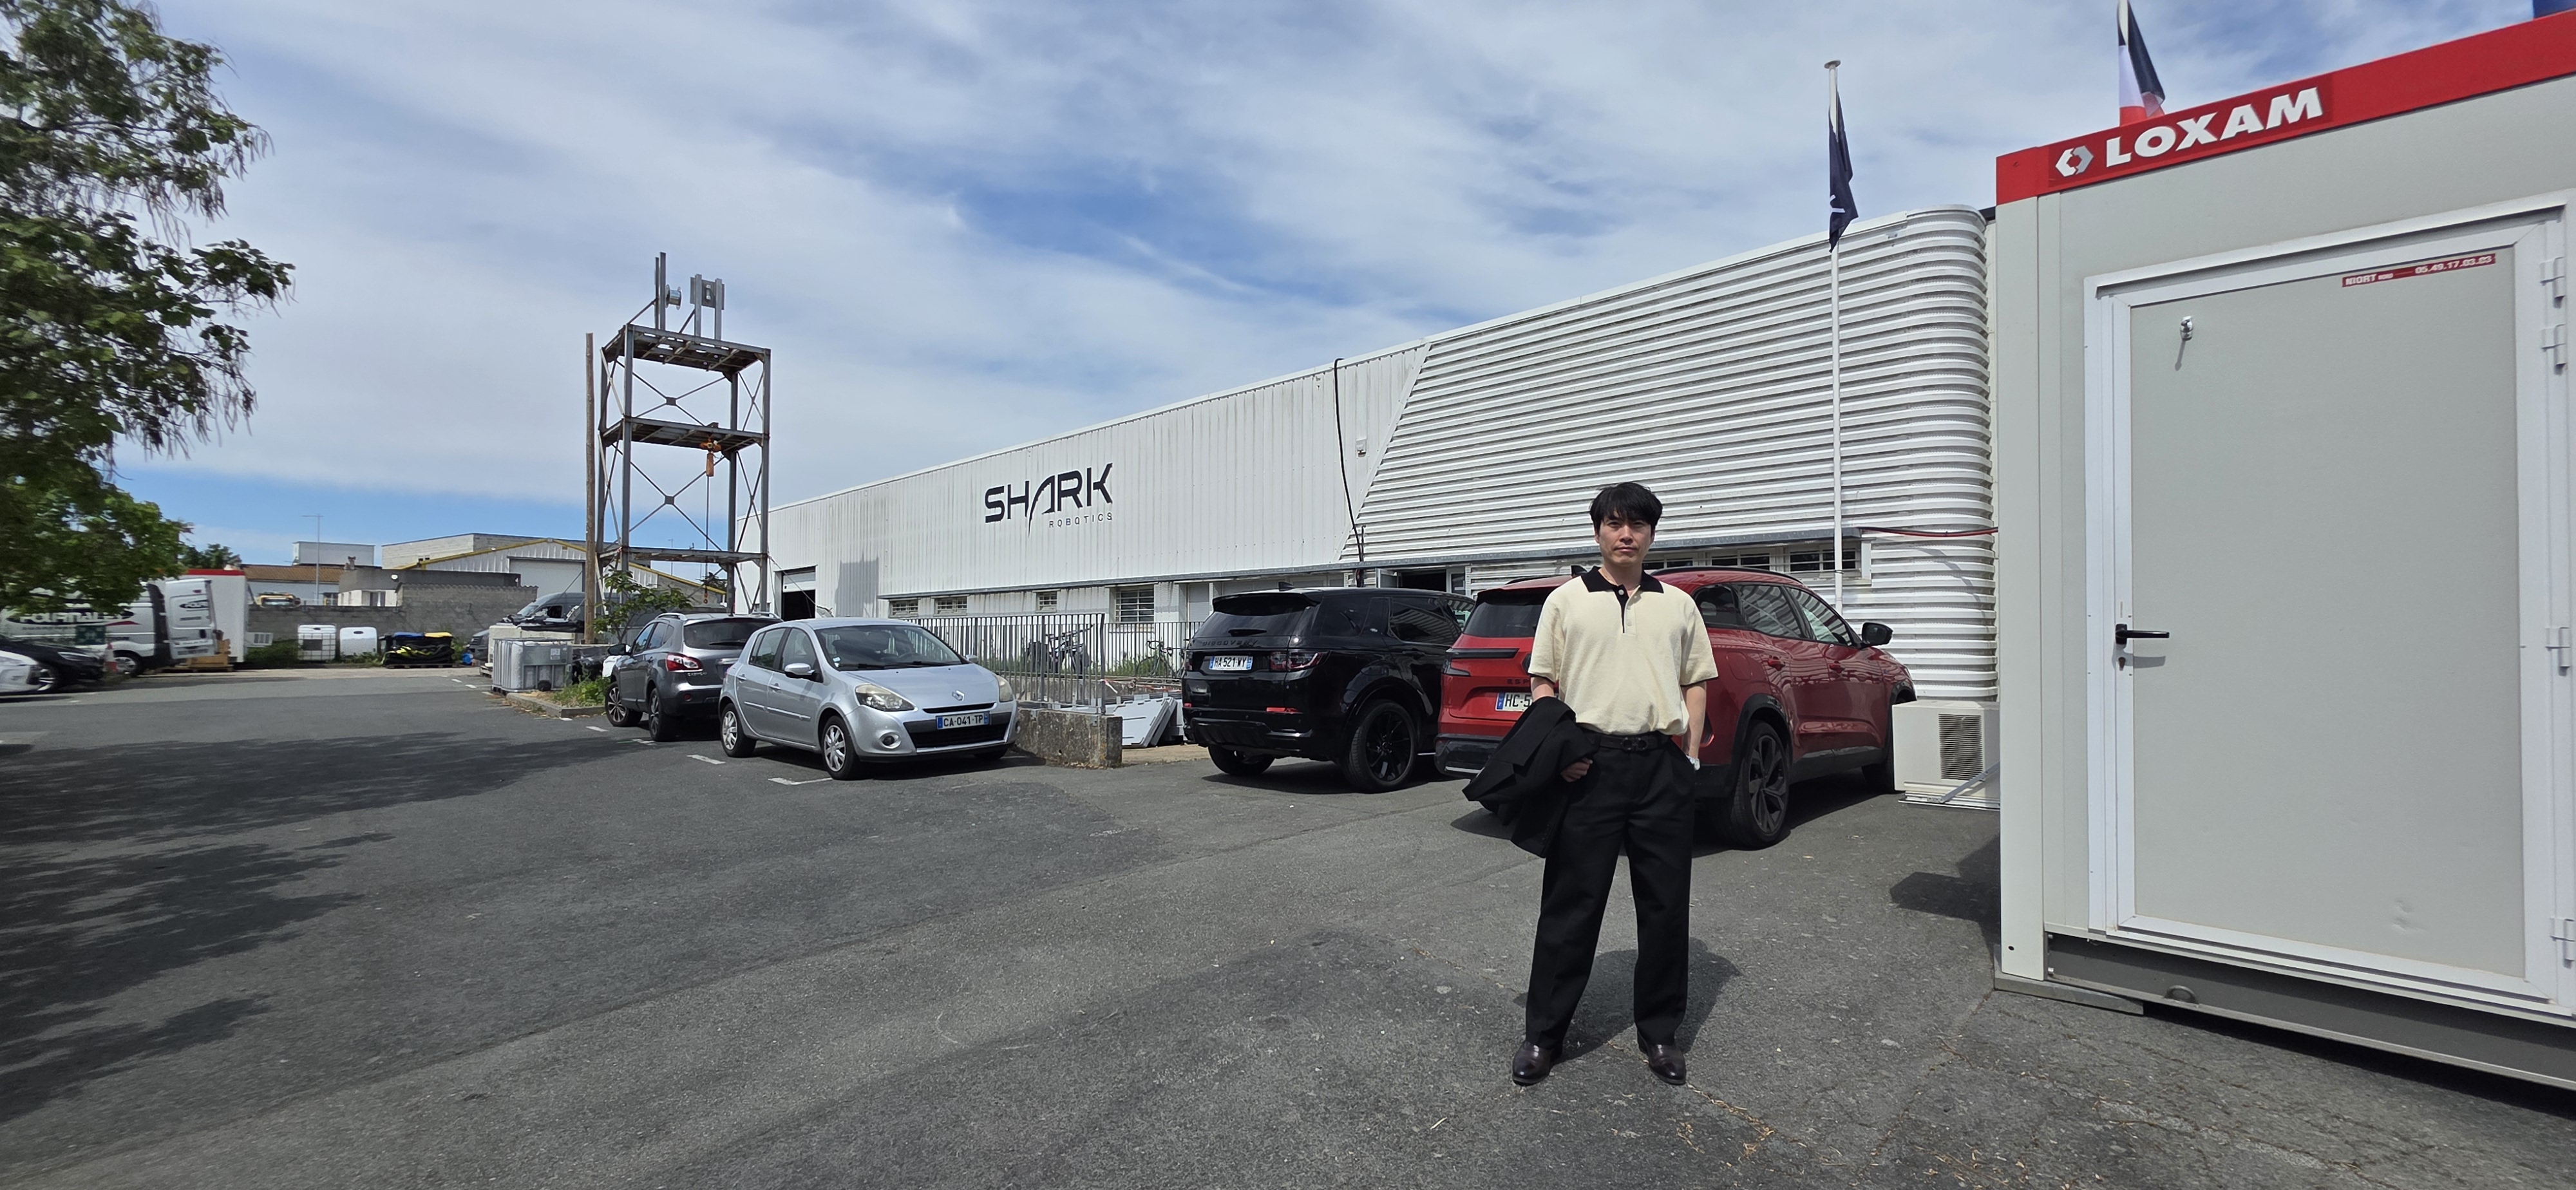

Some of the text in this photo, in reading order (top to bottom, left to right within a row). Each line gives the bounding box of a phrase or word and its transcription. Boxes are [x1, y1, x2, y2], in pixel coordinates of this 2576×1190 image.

[2106, 86, 2323, 167] LOXAM
[2345, 274, 2377, 285] NIORT
[984, 462, 1113, 538] SHARK
[1049, 512, 1113, 528] ROBOTICS
[943, 714, 983, 727] CA-041-TP
